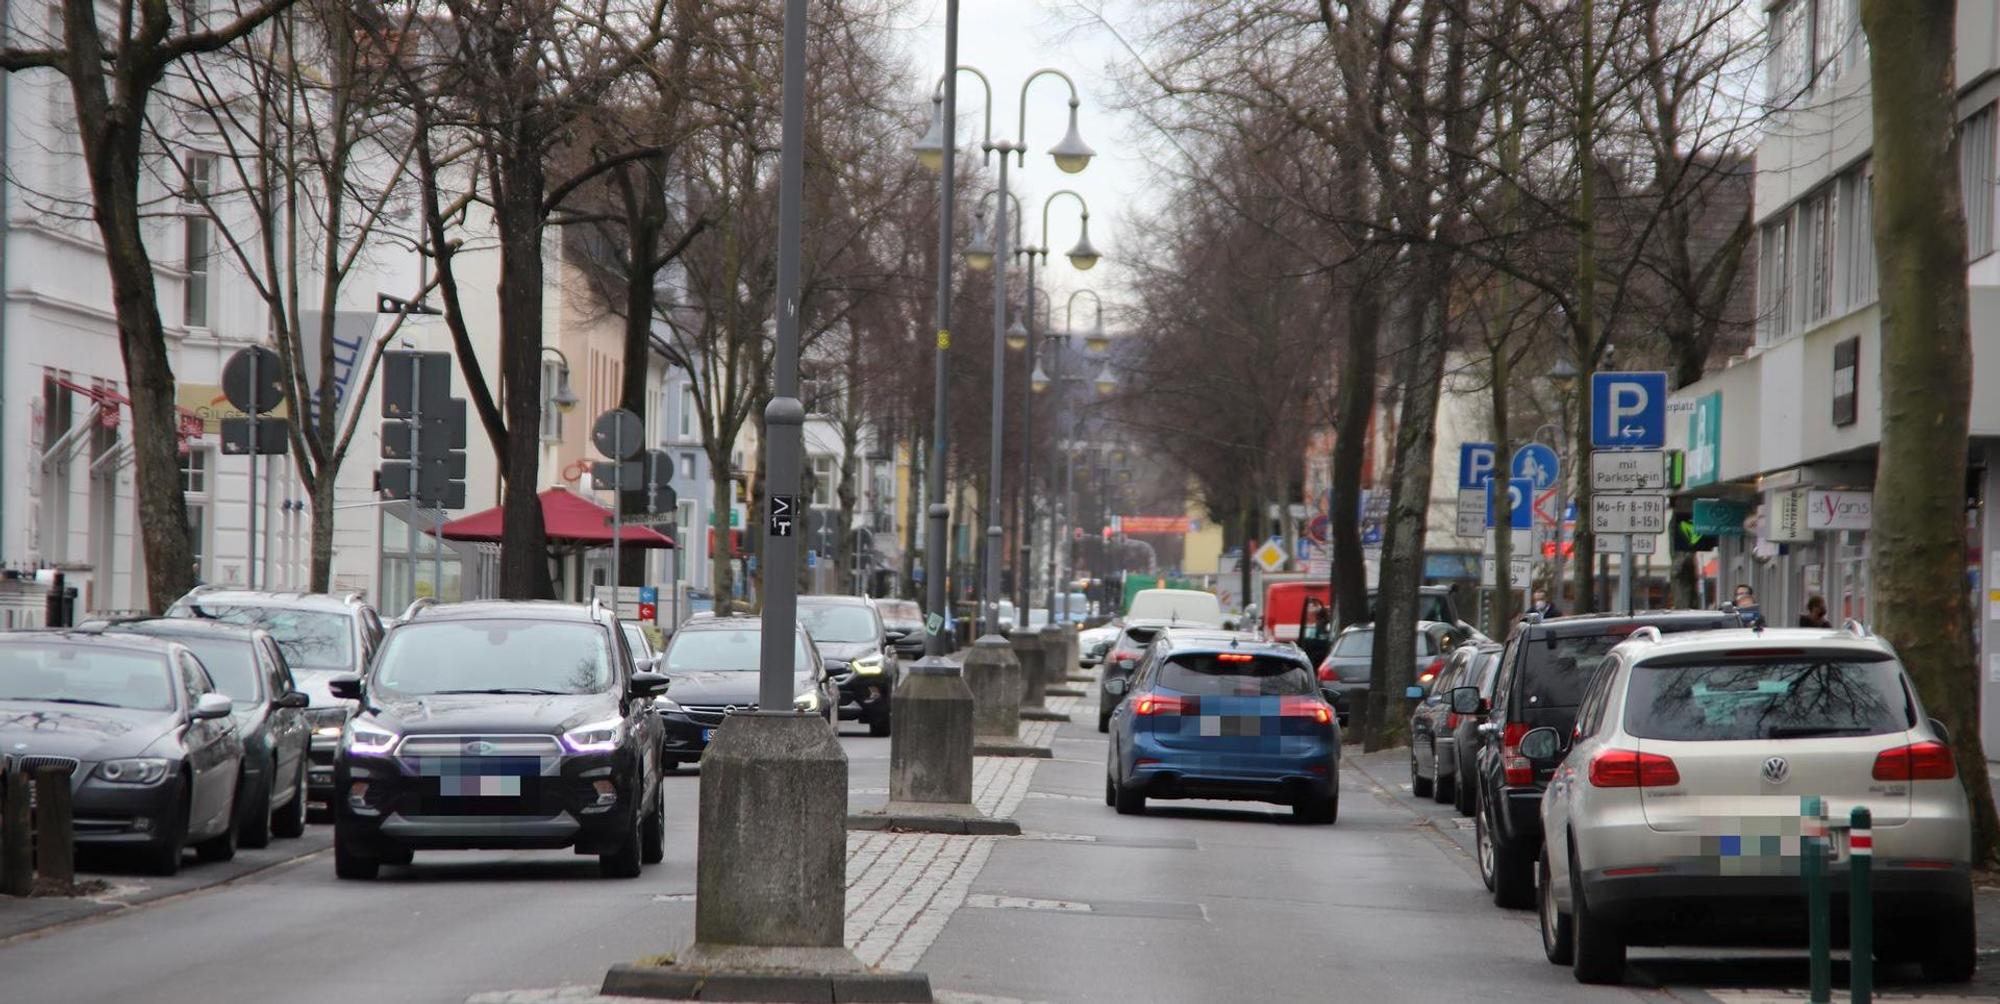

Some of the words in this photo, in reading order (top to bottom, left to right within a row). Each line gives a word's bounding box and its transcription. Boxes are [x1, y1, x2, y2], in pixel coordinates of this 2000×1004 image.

[1609, 382, 1649, 437] P
[1619, 460, 1637, 469] mit
[1597, 472, 1660, 483] Parkschein
[1596, 501, 1626, 513] Mo-Fr
[1596, 516, 1609, 528] Sa
